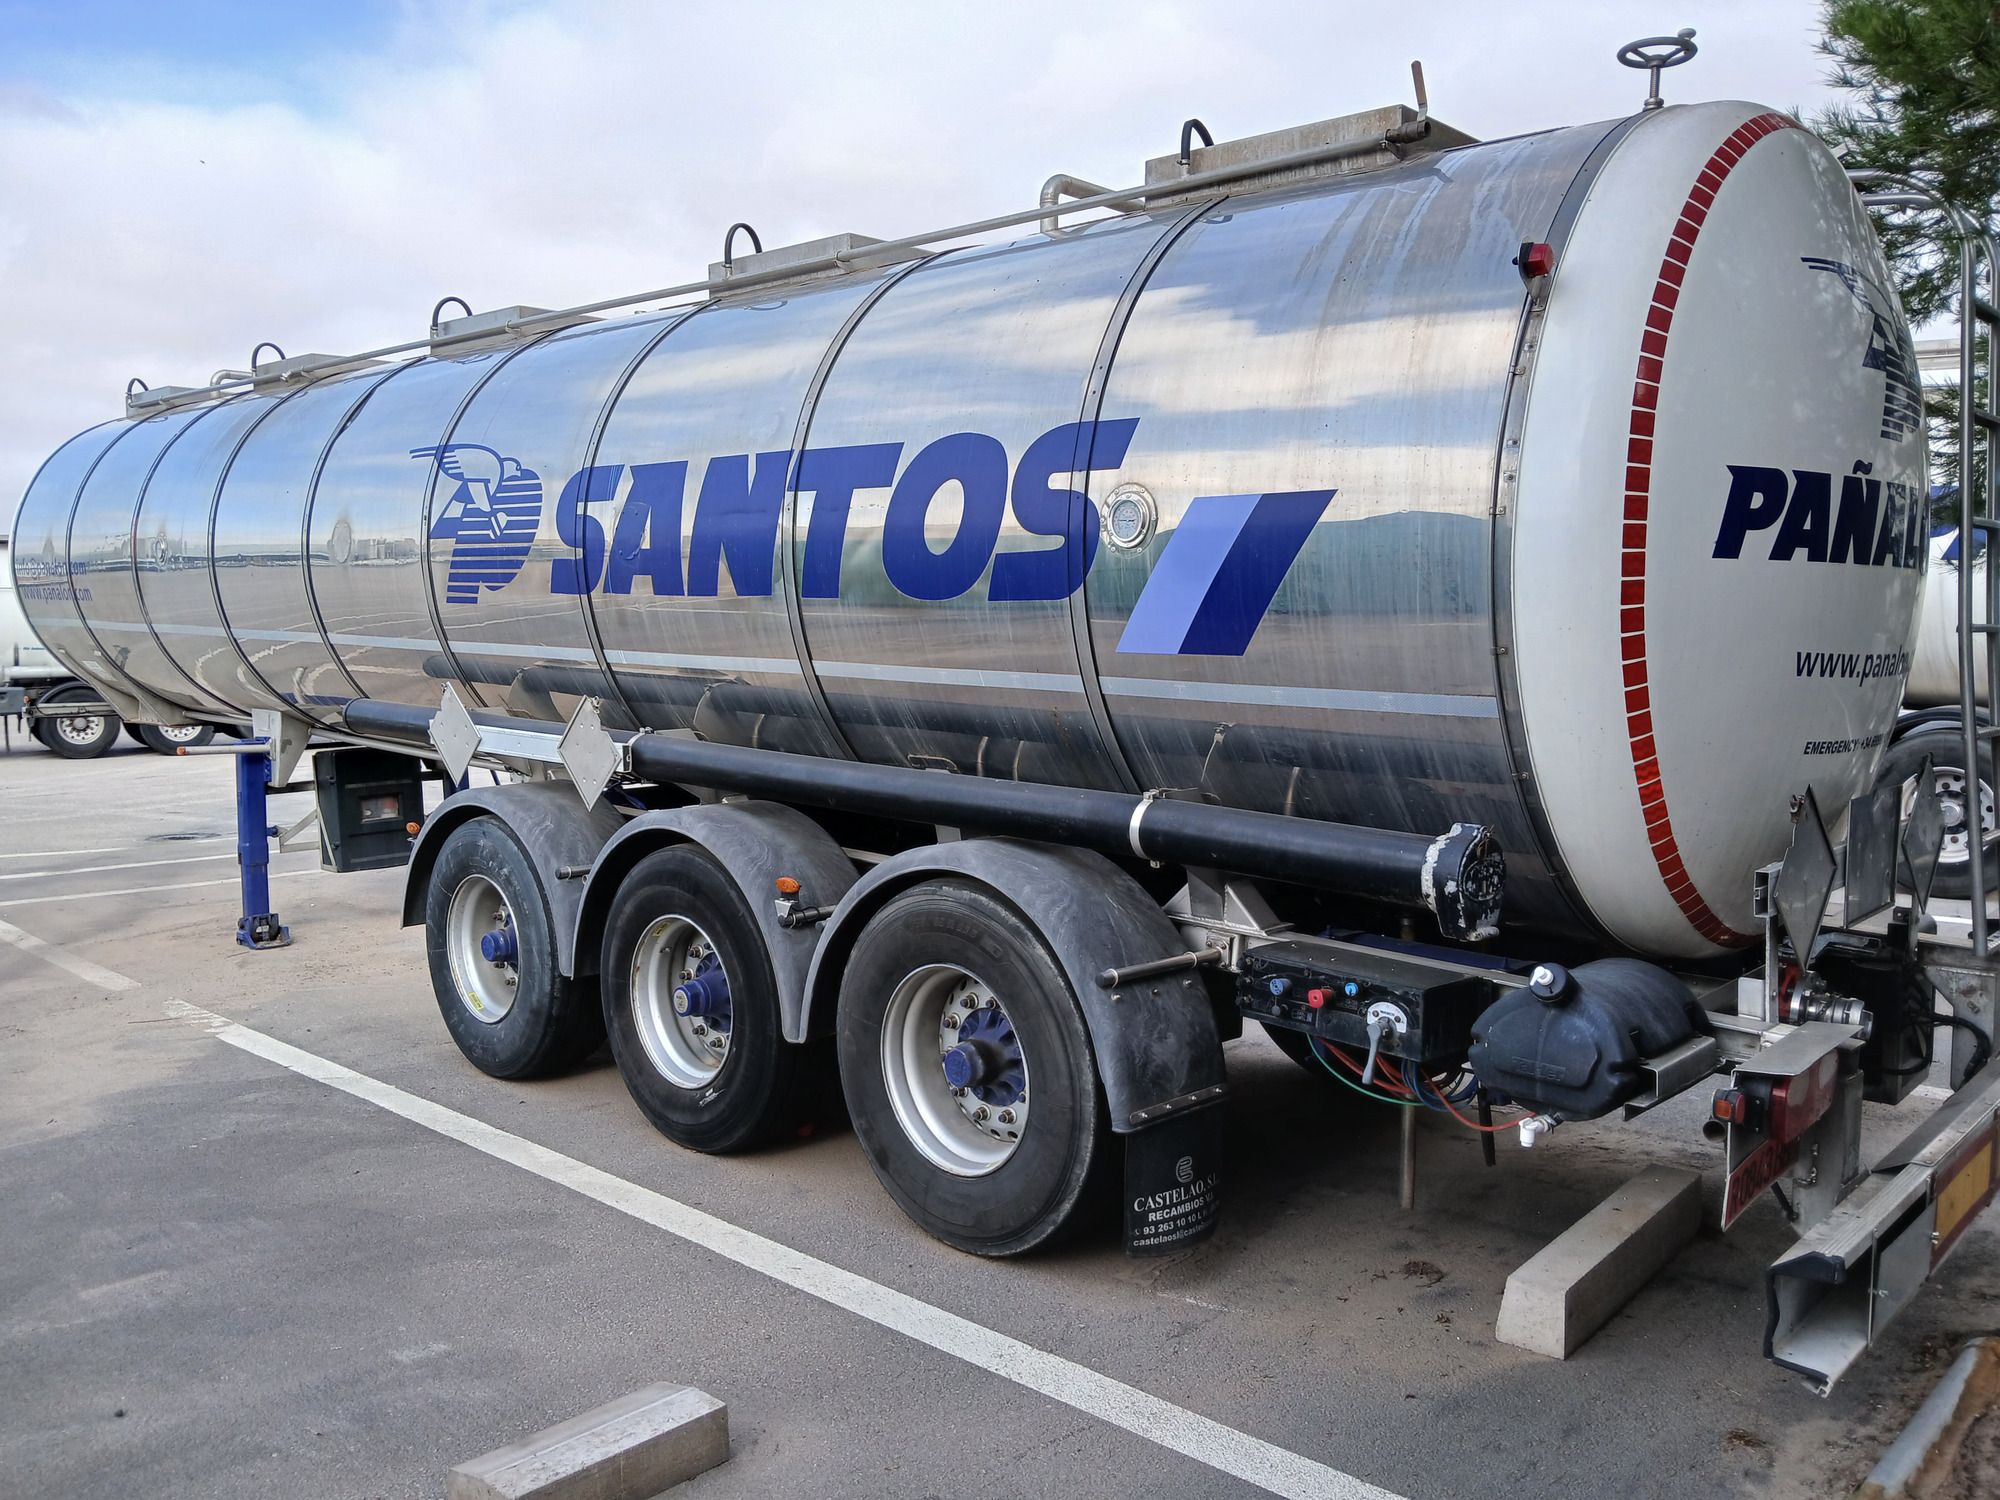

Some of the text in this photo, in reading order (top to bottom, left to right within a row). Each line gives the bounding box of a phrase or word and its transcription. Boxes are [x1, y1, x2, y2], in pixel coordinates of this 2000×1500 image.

[551, 417, 1140, 602] SANTOS
[1148, 1196, 1205, 1222] RECAMBIOS
[1143, 1213, 1197, 1235] 93 263 10 10
